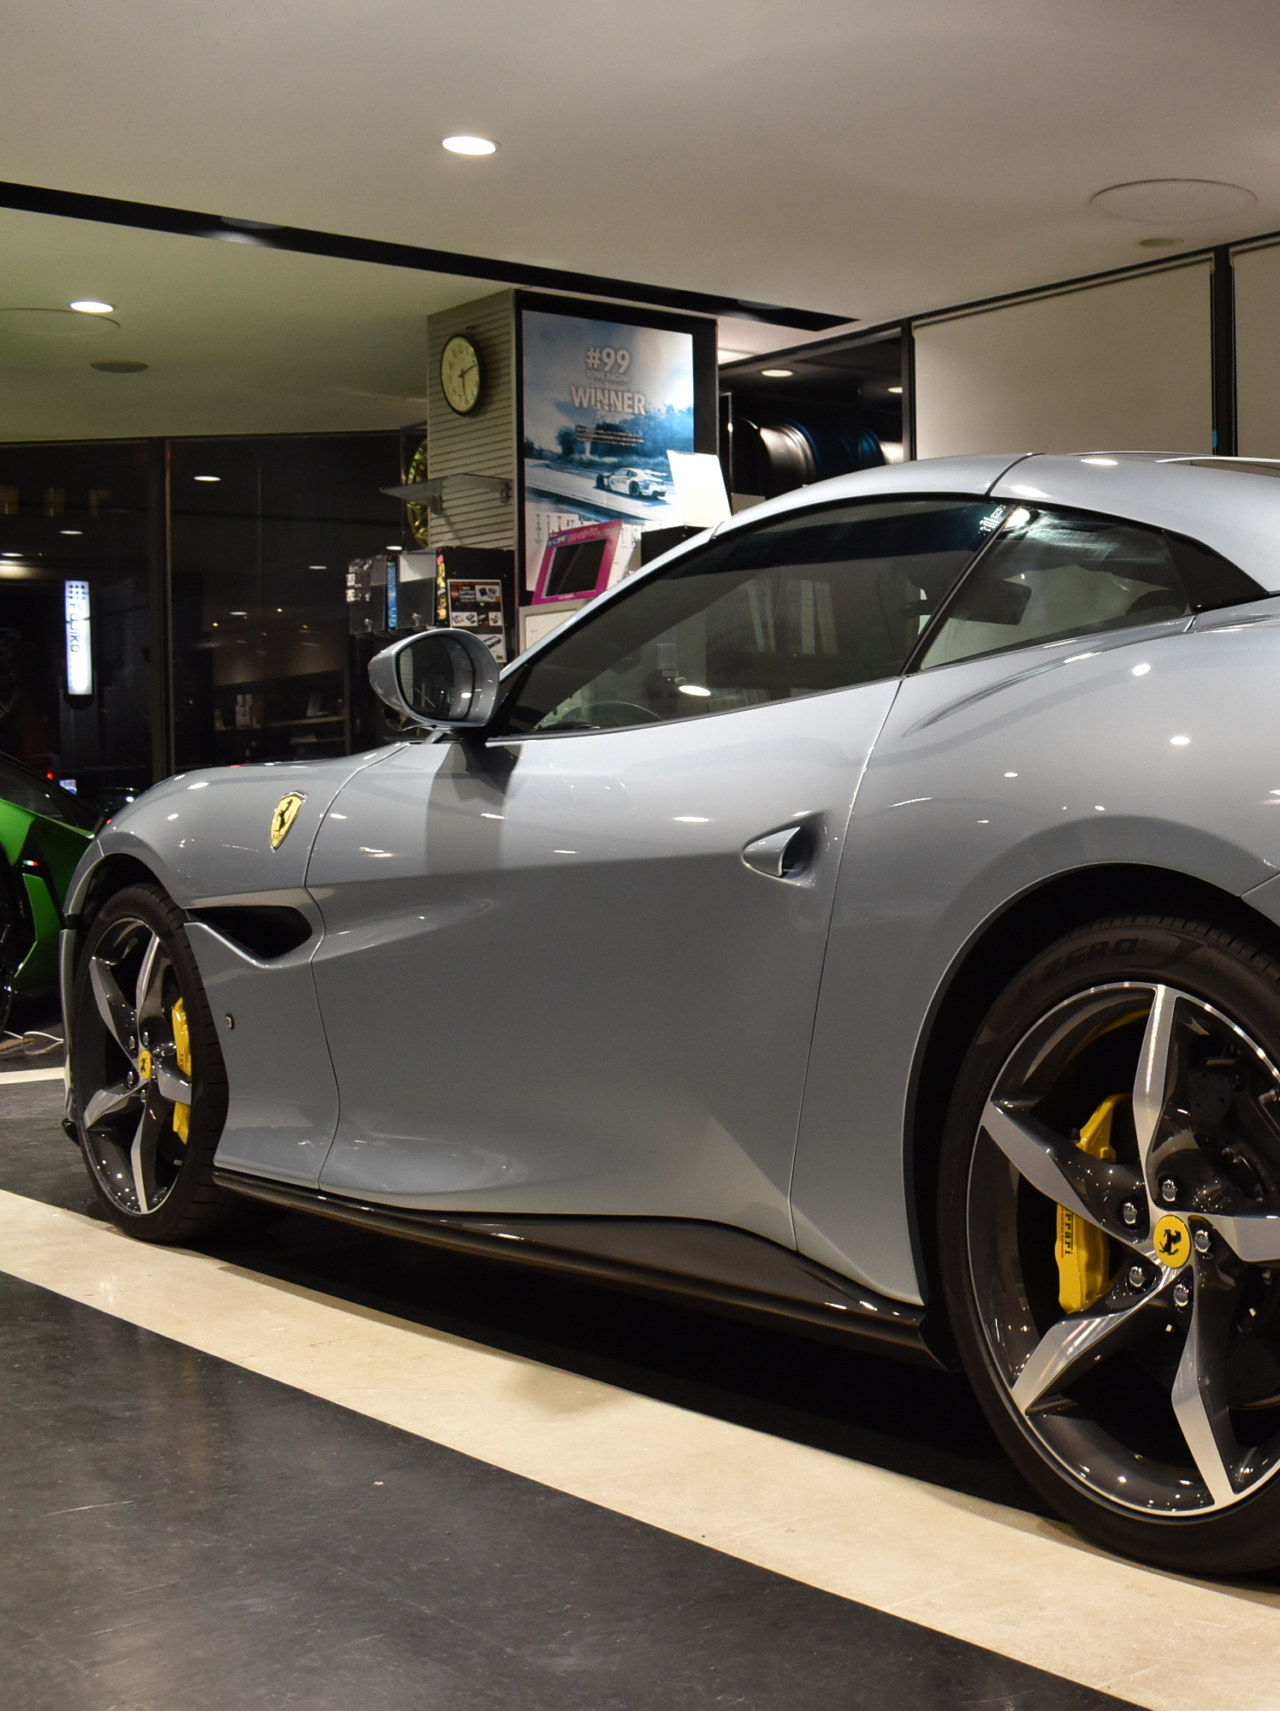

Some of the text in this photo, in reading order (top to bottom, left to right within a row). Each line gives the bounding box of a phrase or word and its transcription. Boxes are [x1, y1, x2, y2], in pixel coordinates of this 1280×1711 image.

[586, 347, 631, 374] #99
[571, 385, 647, 416] WINNER
[69, 603, 81, 653] FUJIKO
[1065, 1208, 1073, 1255] rrari
